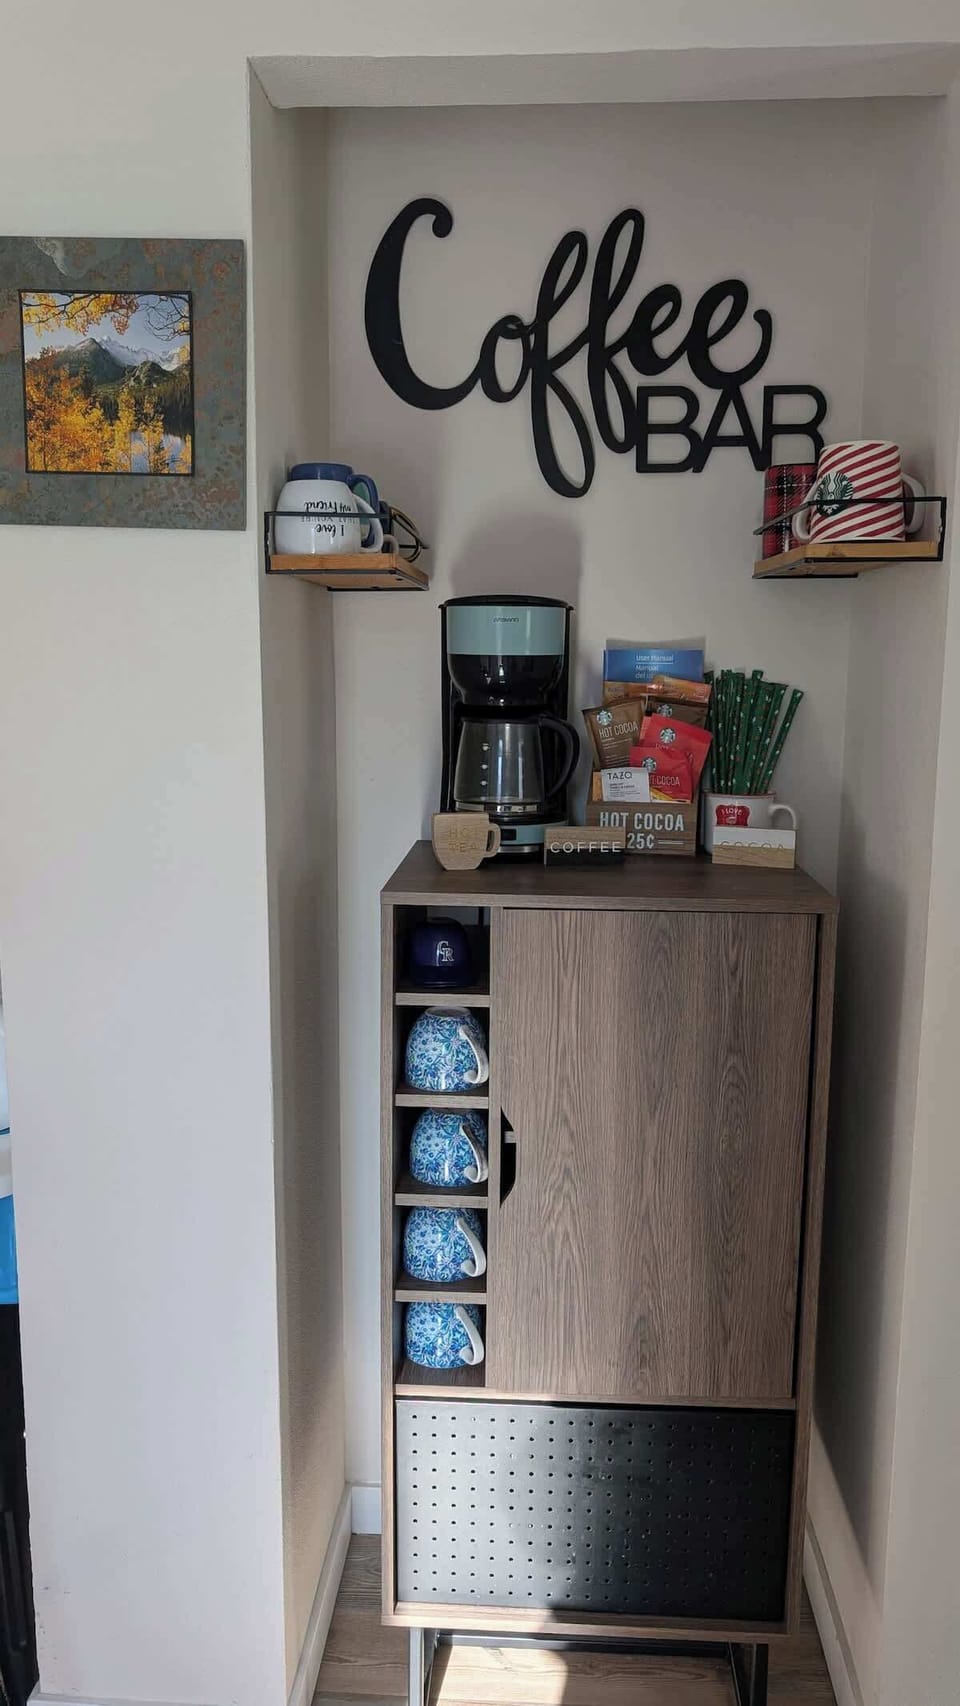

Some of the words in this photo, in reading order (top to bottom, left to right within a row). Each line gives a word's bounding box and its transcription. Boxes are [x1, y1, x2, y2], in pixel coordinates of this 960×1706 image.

[364, 197, 772, 498] Coffee
[636, 384, 827, 473] BAR
[316, 524, 336, 537] love
[598, 727, 613, 738] HOT
[614, 722, 638, 735] COCOA
[606, 771, 633, 781] TAZO
[657, 776, 681, 787] COCOA
[599, 811, 629, 828] HOT
[633, 812, 685, 831] COCOA
[550, 841, 622, 854] COFFEE
[626, 832, 655, 850] 25¢
